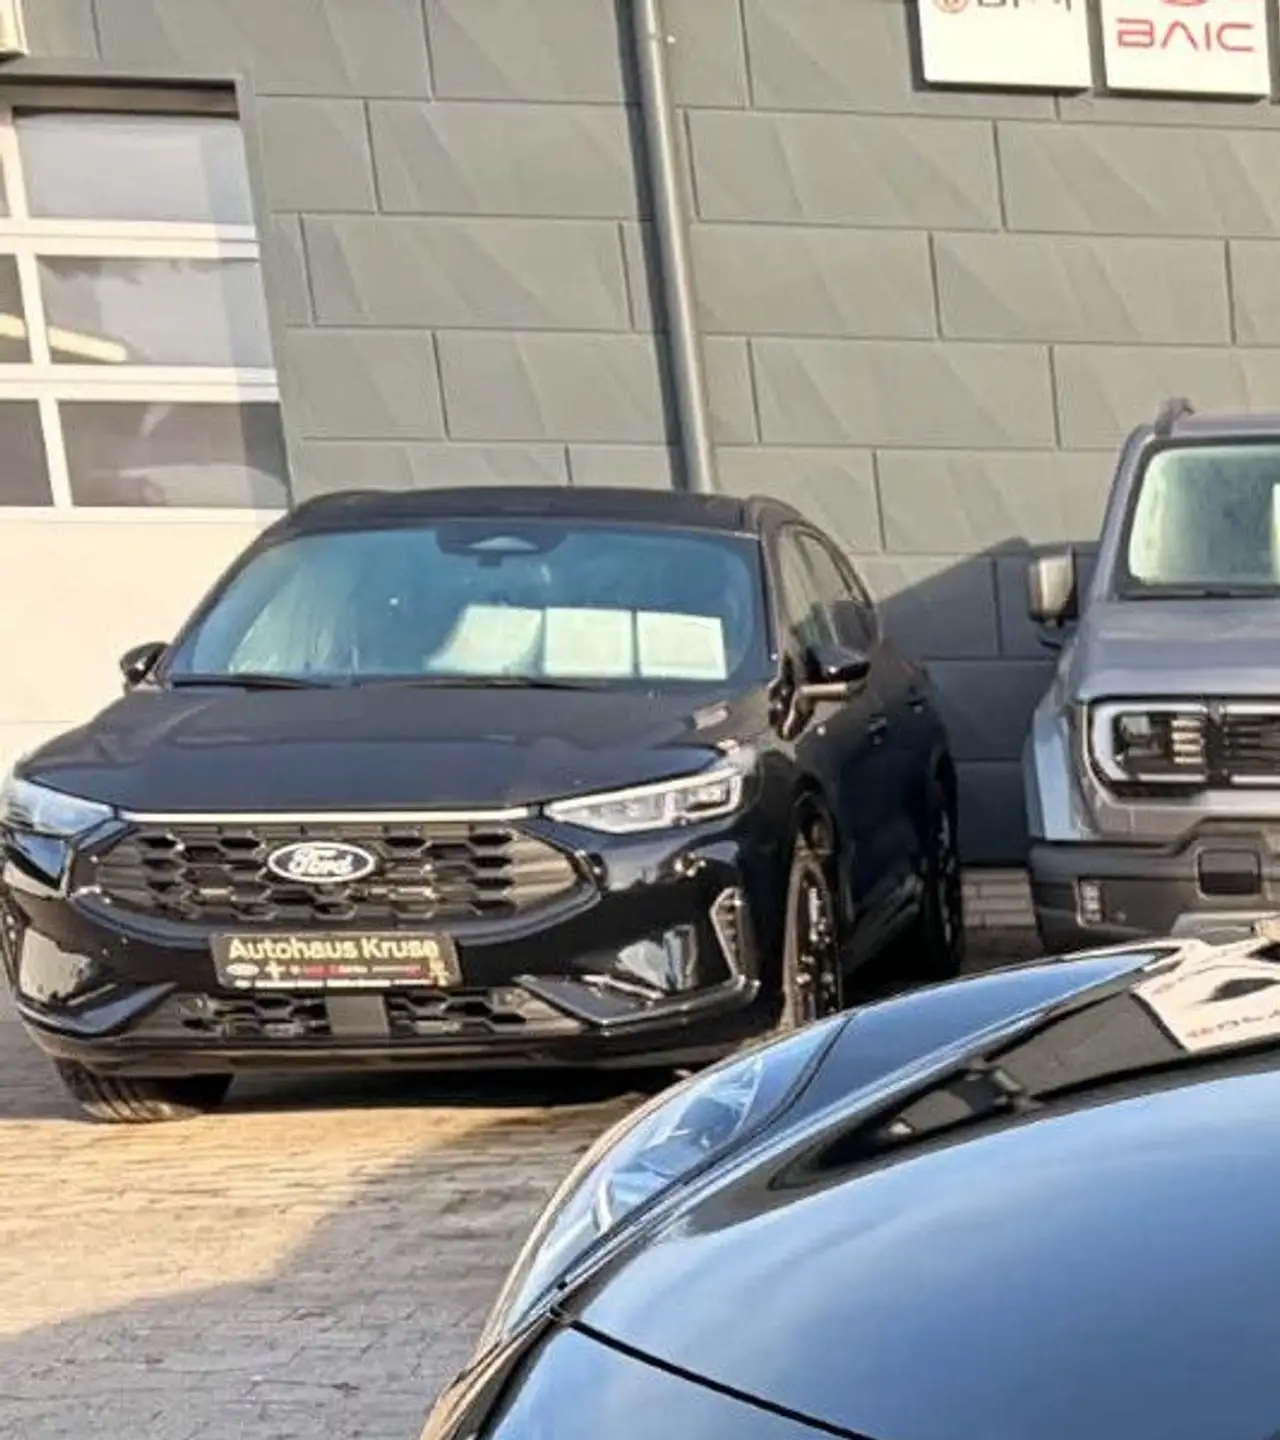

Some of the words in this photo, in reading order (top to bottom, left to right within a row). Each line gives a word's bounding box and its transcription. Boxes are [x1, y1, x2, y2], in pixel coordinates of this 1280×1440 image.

[1115, 17, 1256, 53] BAIC
[284, 844, 358, 876] Ford
[228, 935, 358, 960] Autohaus
[360, 937, 440, 959] Kruse
